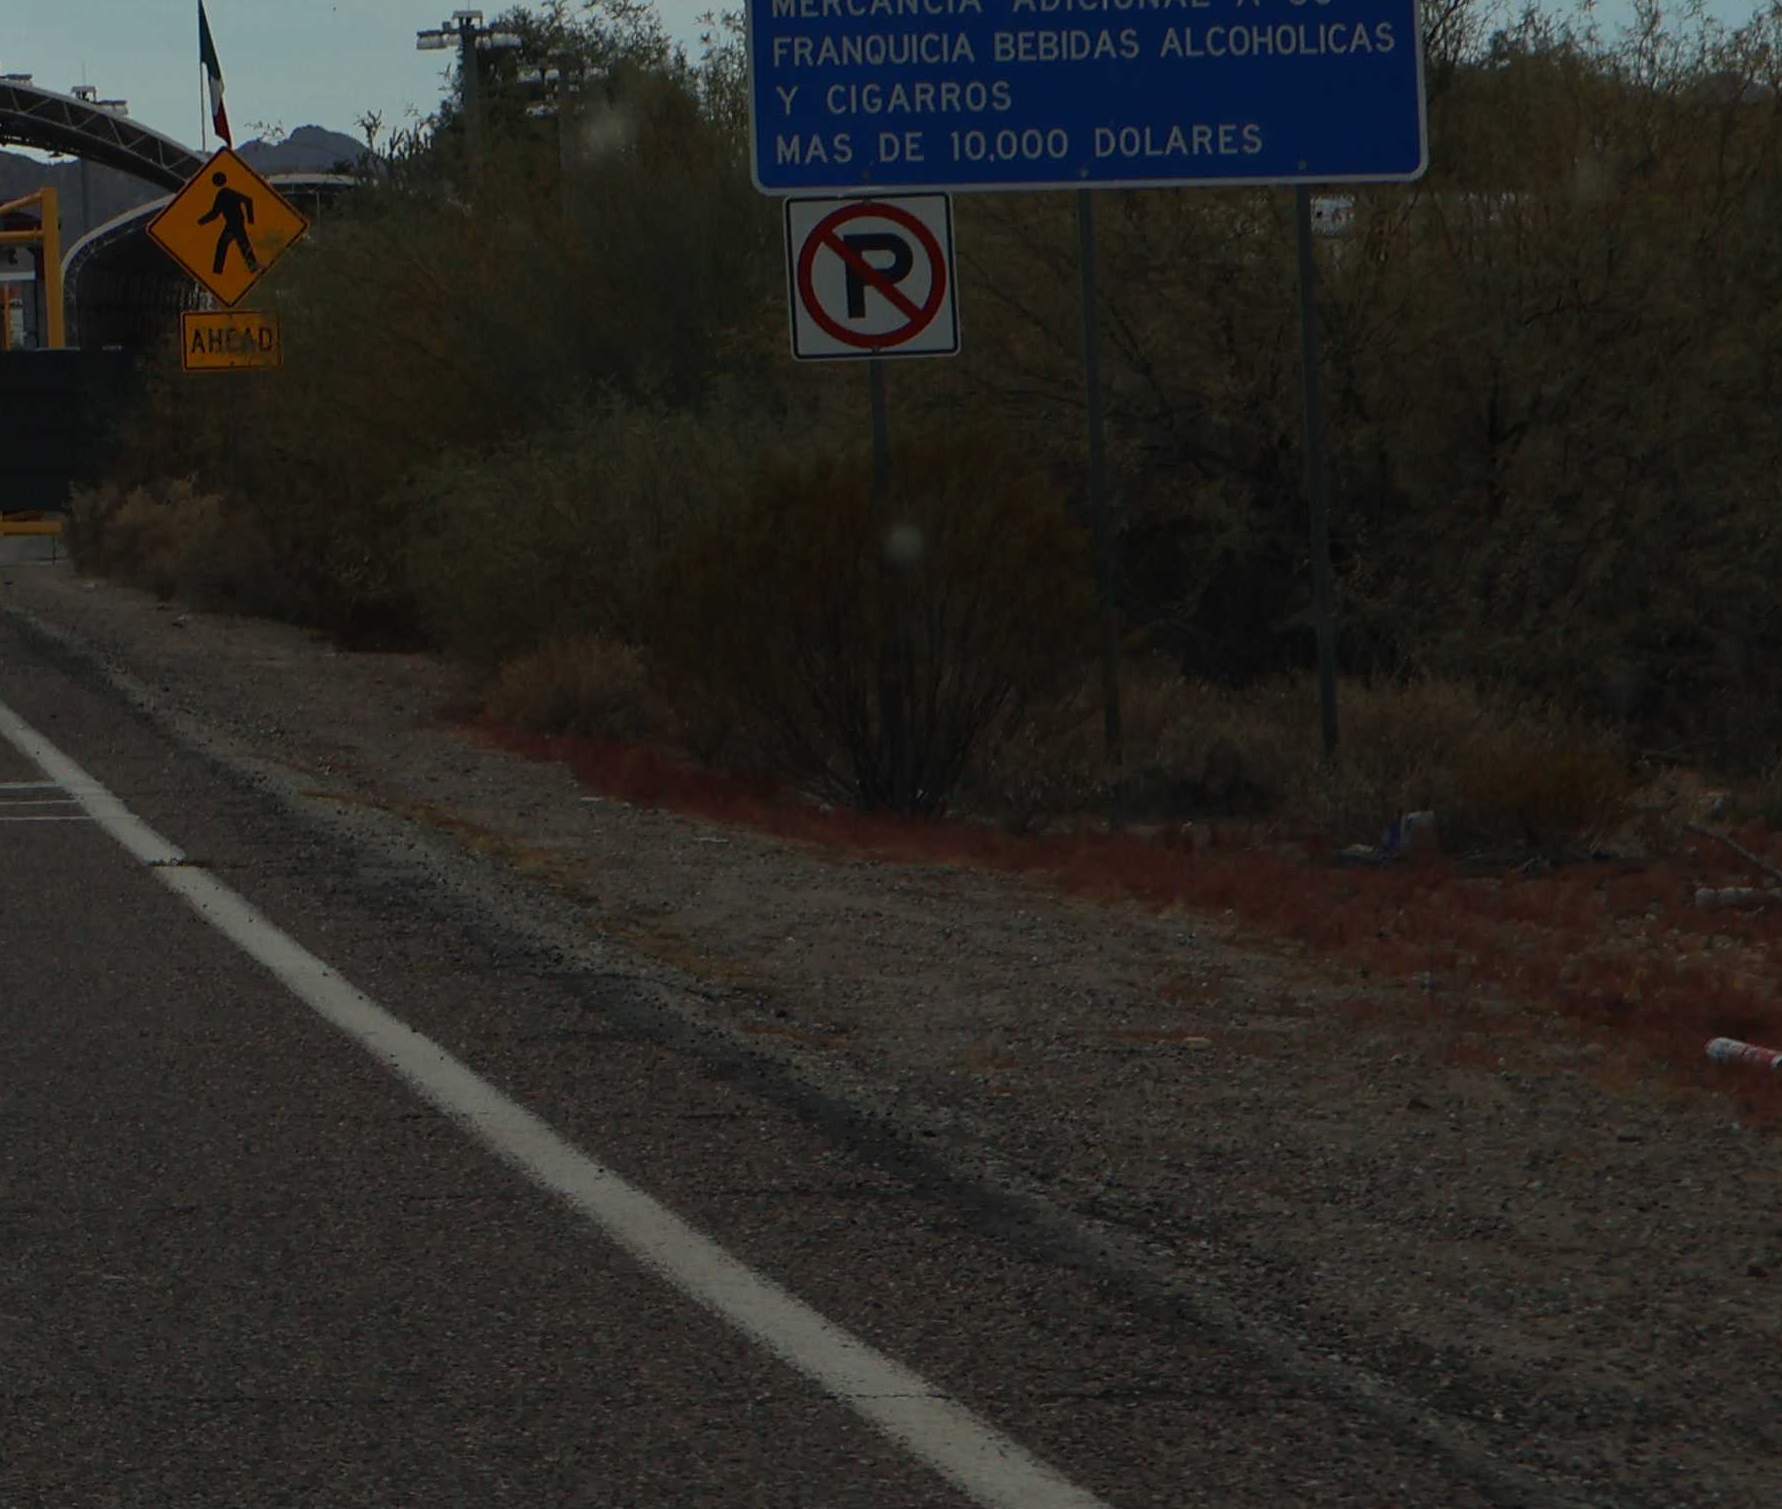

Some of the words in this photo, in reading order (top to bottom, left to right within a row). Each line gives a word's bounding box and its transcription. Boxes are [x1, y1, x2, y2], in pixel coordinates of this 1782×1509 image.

[774, 33, 974, 67] FRANQUICIA
[995, 28, 1140, 60] BEBIDAS
[1161, 23, 1394, 57] ALCOHOLICAS
[776, 86, 797, 115] Y
[827, 81, 1011, 113] CIGARROS
[777, 134, 852, 163] MAS
[880, 132, 924, 161] DE
[1095, 123, 1261, 156] DOLARES
